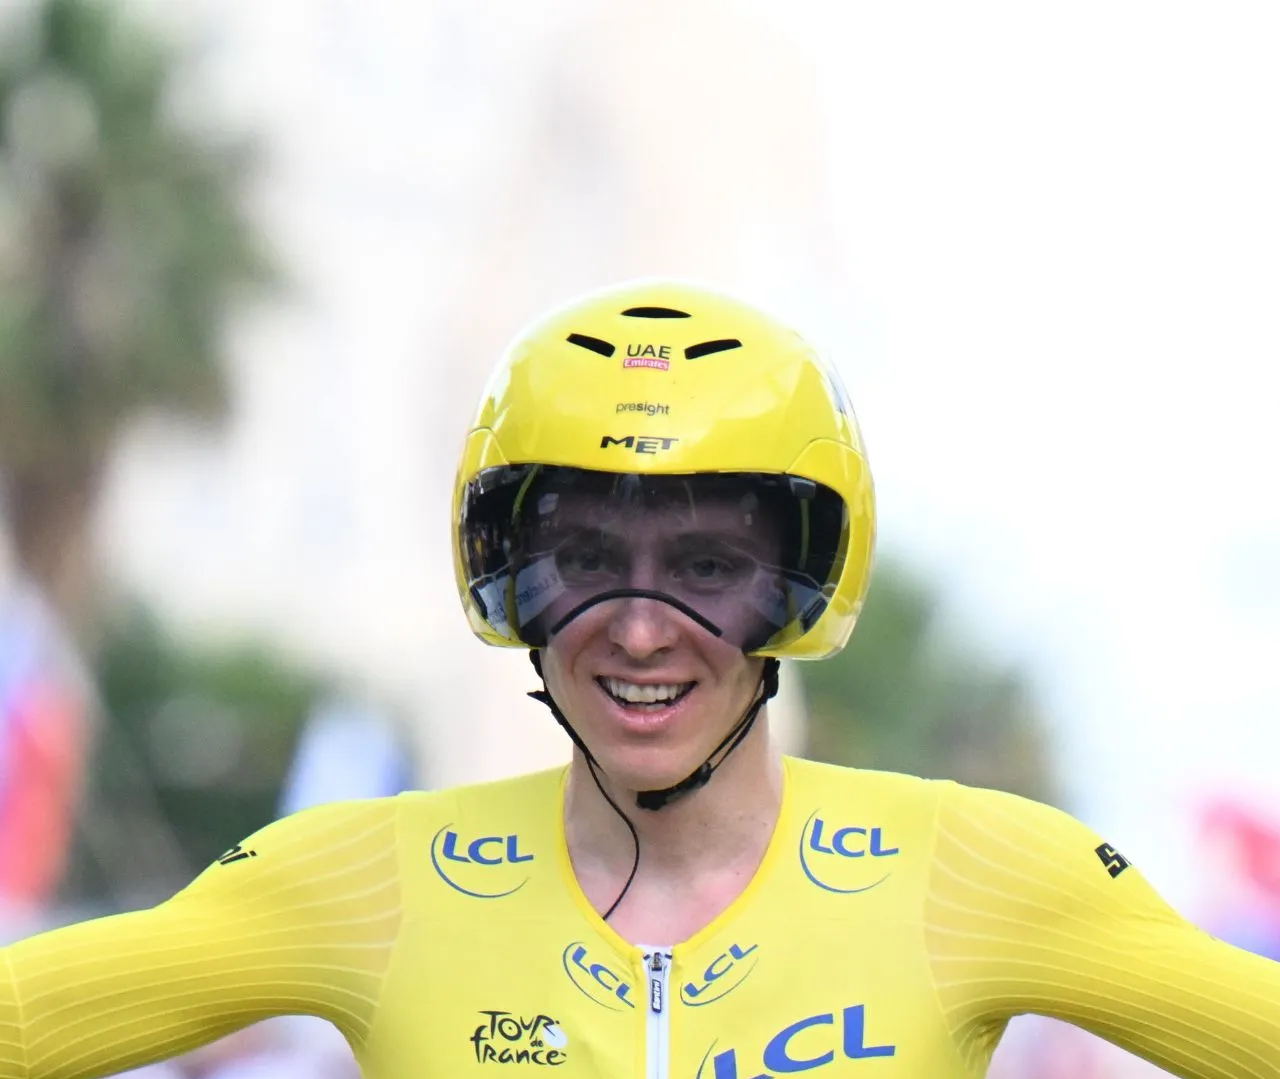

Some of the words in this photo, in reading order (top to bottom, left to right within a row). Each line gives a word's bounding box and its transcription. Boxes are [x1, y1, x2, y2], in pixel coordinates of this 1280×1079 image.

[624, 358, 668, 370] Emirates
[627, 344, 672, 359] UAE
[616, 401, 670, 416] presight
[600, 435, 679, 455] MET
[443, 832, 534, 865] LCL
[810, 818, 899, 858] LCL
[572, 946, 635, 1009] LCL
[684, 943, 759, 998] LCL
